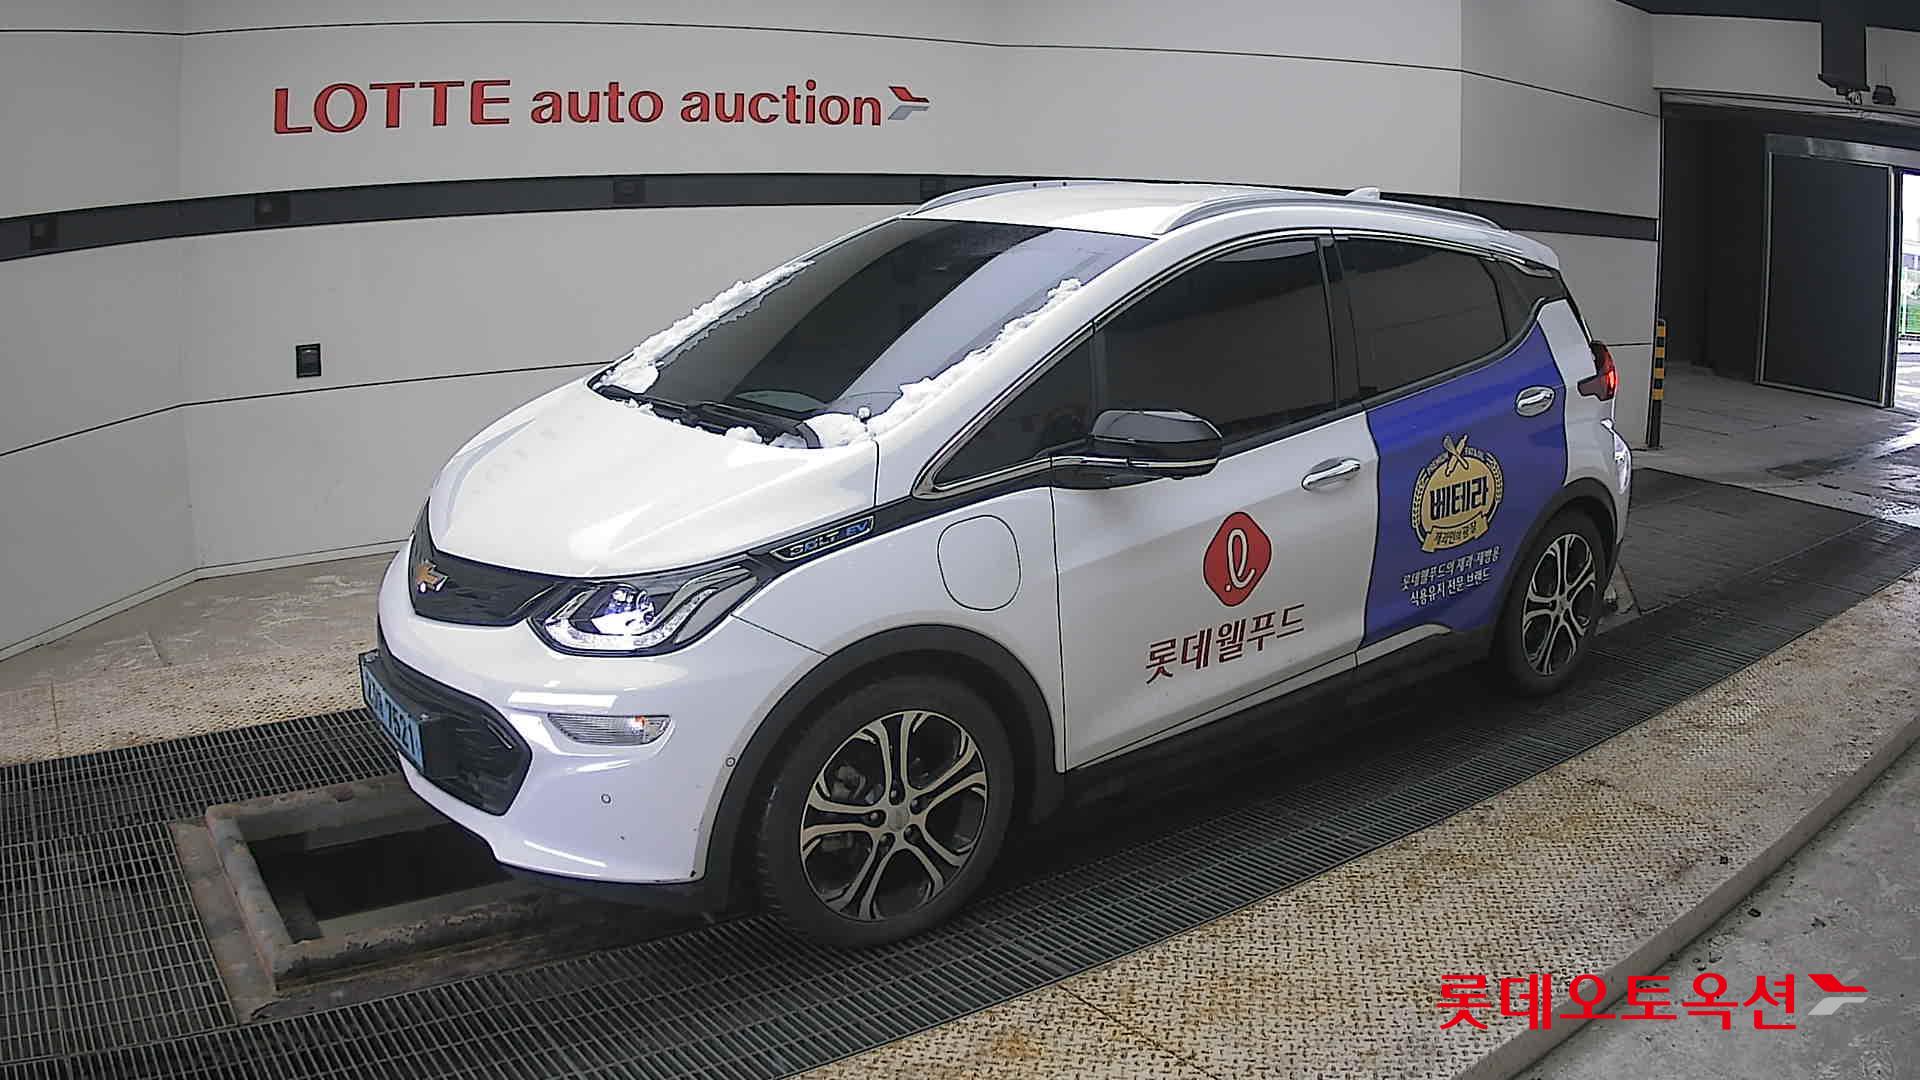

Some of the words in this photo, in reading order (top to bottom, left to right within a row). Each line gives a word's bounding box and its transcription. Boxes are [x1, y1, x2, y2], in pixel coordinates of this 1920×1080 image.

[272, 79, 511, 135] LOTTE
[530, 80, 664, 125] auto
[680, 80, 882, 127] auction
[1430, 476, 1488, 521] 베테라
[1410, 581, 1446, 607] 식용유지
[1447, 576, 1465, 595] 전문
[1465, 567, 1492, 587] 브랜드
[1145, 603, 1305, 685] 롯데웰푸드
